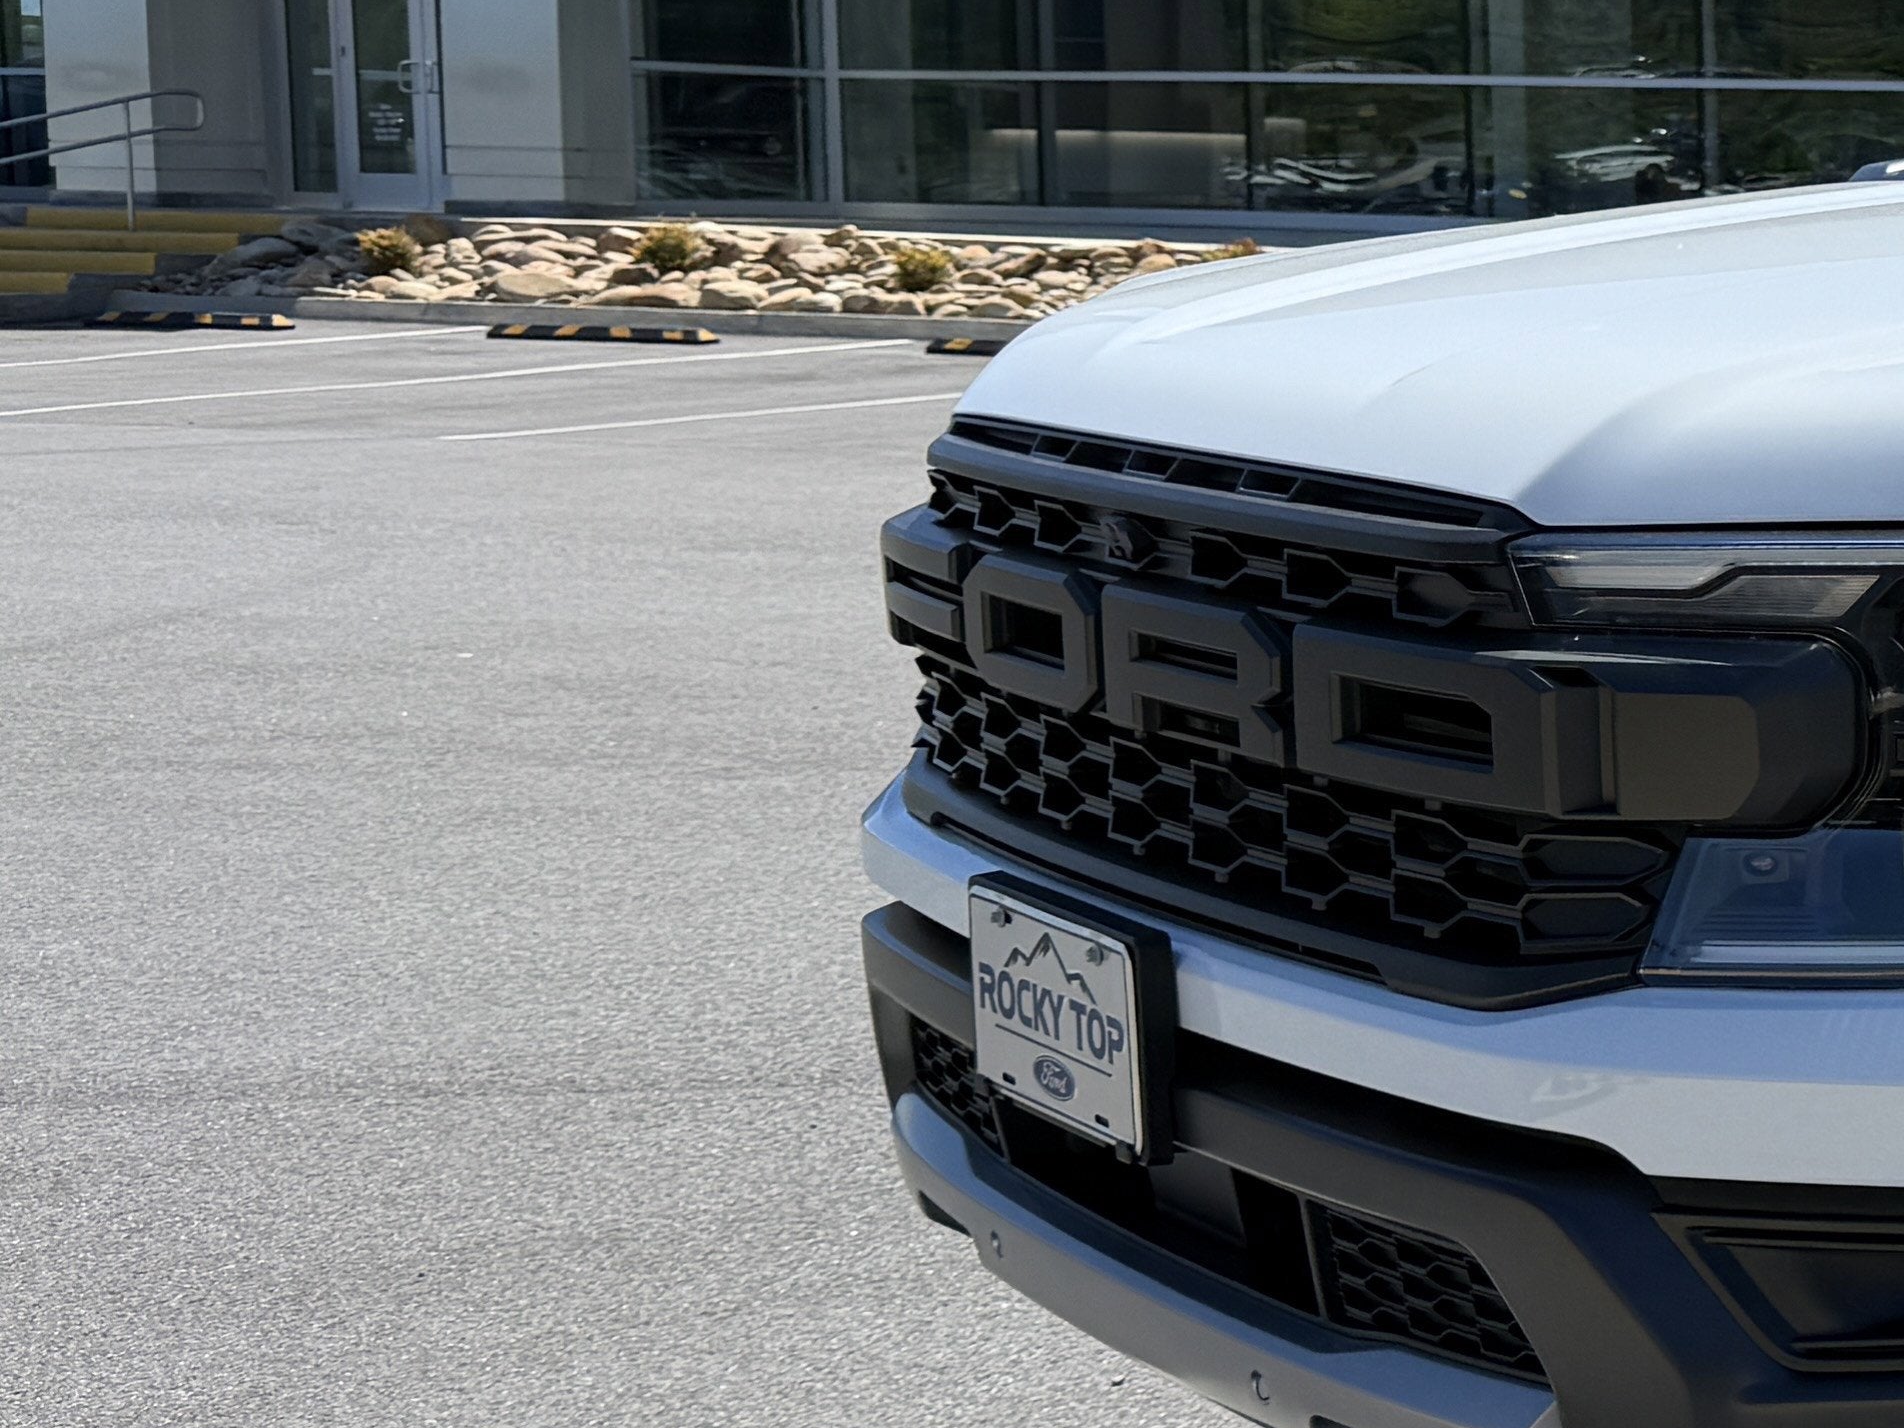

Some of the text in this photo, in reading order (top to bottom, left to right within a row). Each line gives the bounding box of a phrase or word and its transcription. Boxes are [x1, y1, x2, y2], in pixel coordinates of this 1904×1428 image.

[880, 508, 1557, 815] FORD
[979, 961, 1125, 1065] ROCKY TOP
[1041, 1062, 1068, 1093] Ford
